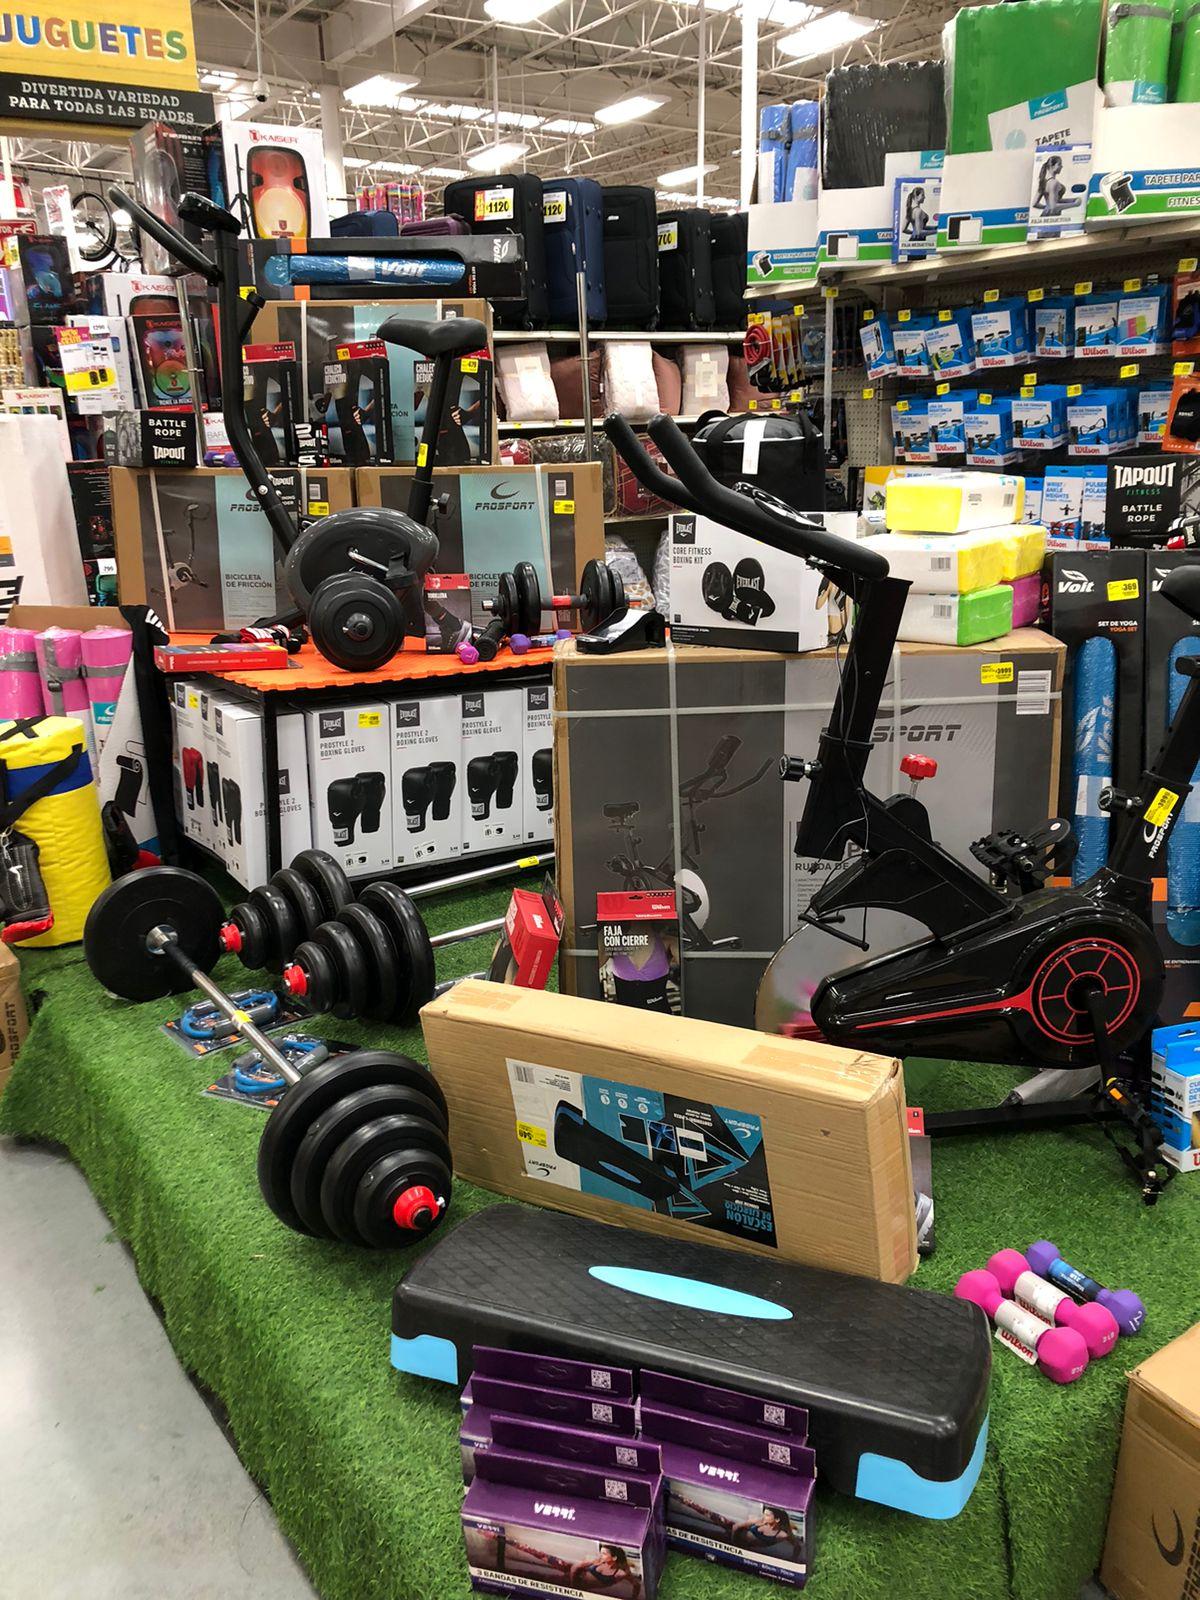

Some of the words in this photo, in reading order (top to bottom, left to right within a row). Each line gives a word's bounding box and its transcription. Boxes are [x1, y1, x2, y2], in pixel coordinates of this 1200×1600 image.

[0, 13, 188, 61] JUGUETES
[21, 81, 104, 101] DIVERTIDA
[106, 90, 180, 108] VARIEDAD
[9, 96, 50, 110] PARA
[54, 100, 104, 116] TODAS
[108, 105, 136, 118] LAS
[140, 107, 195, 124] EDADES
[1035, 128, 1071, 146] TAPETE
[1144, 174, 1181, 185] TAPETE
[488, 201, 509, 213] 1120
[1083, 347, 1109, 355] Wilson
[982, 358, 1005, 366] Wilson
[149, 418, 187, 428] BATTLE
[155, 428, 182, 437] ROPE
[935, 444, 957, 452] Wilson
[1019, 439, 1045, 448] Wilson
[152, 445, 186, 461] TAPOUT
[1075, 446, 1100, 454] Wilson
[972, 456, 995, 465] Wilson
[1114, 462, 1177, 490] TAPOUT
[474, 501, 537, 511] PROSPORT
[1122, 504, 1163, 513] BATTLE
[1127, 515, 1156, 523] ROPE
[673, 547, 687, 555] CORE
[688, 547, 712, 556] FITNESS
[673, 556, 693, 564] BOXING
[694, 556, 703, 564] KIT
[237, 580, 272, 588] FRICCIÓN
[736, 575, 760, 591] EVERLAST
[1058, 580, 1095, 593] Voit
[462, 721, 488, 729] PROSTYLE
[396, 730, 423, 738] PROSTYLE
[462, 728, 481, 736] BOXING
[483, 726, 502, 734] GLOVES
[320, 740, 348, 750] PROSTYLE
[396, 738, 417, 746] BOXING
[419, 736, 439, 744] GLOVES
[320, 748, 342, 757] BOXING
[344, 746, 365, 755] GLOVES
[603, 925, 622, 936] FAJA
[604, 936, 621, 946] CON
[622, 935, 649, 946] CIERRE
[725, 1201, 758, 1216] EJERCICIO
[759, 1208, 771, 1220] DE
[726, 1210, 773, 1232] ESCALÓN
[1020, 1300, 1051, 1325] Wilson
[1001, 1330, 1034, 1359] Wilson
[678, 1531, 689, 1541] DE
[690, 1535, 743, 1556] RESISTENCIA
[483, 1570, 517, 1585] BANDAS
[518, 1577, 529, 1586] DE
[530, 1580, 584, 1599] RESISTENCIA
